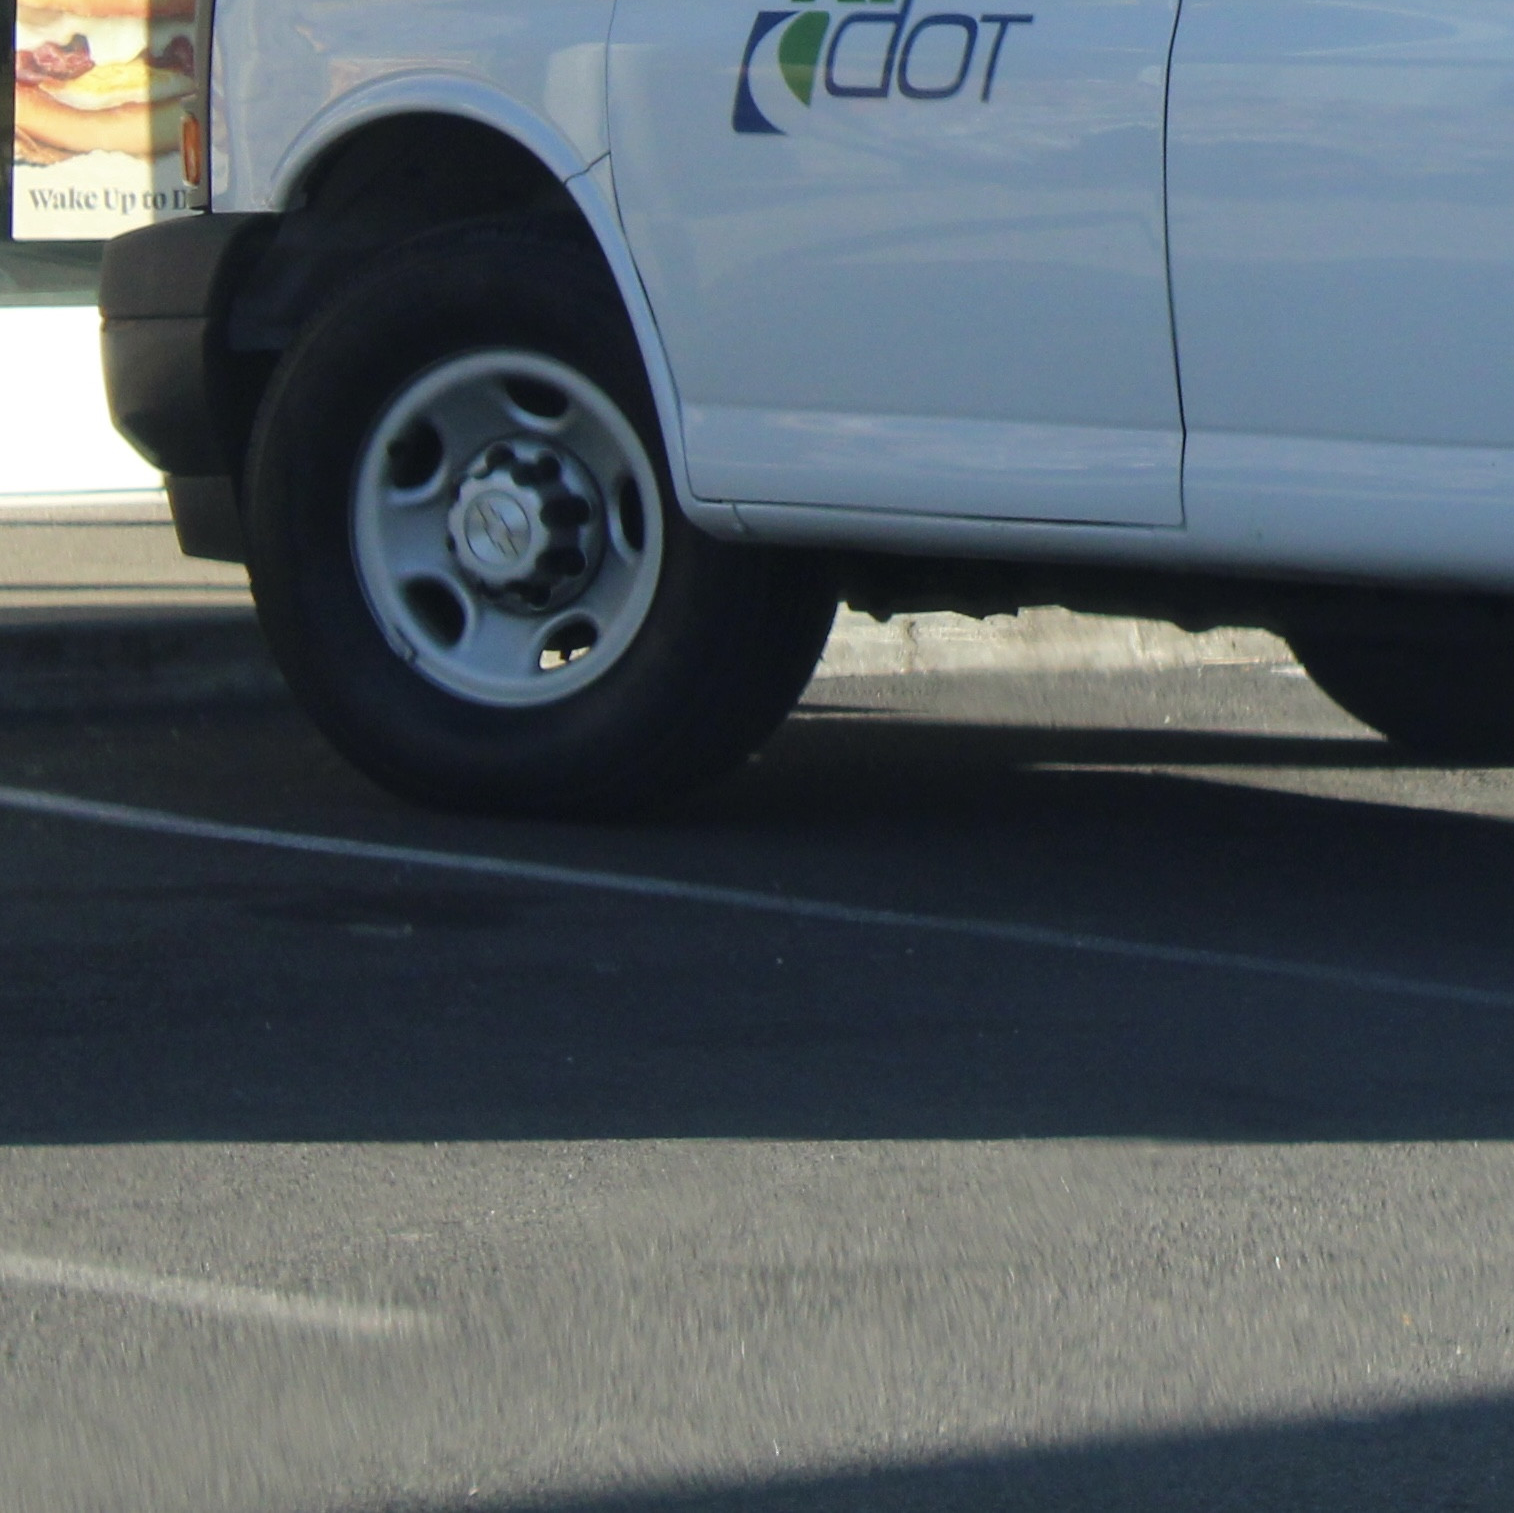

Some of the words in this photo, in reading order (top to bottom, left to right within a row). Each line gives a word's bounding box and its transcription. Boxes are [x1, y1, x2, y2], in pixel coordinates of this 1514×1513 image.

[29, 187, 97, 211] Wake
[104, 188, 136, 216] Up
[143, 191, 166, 211] to
